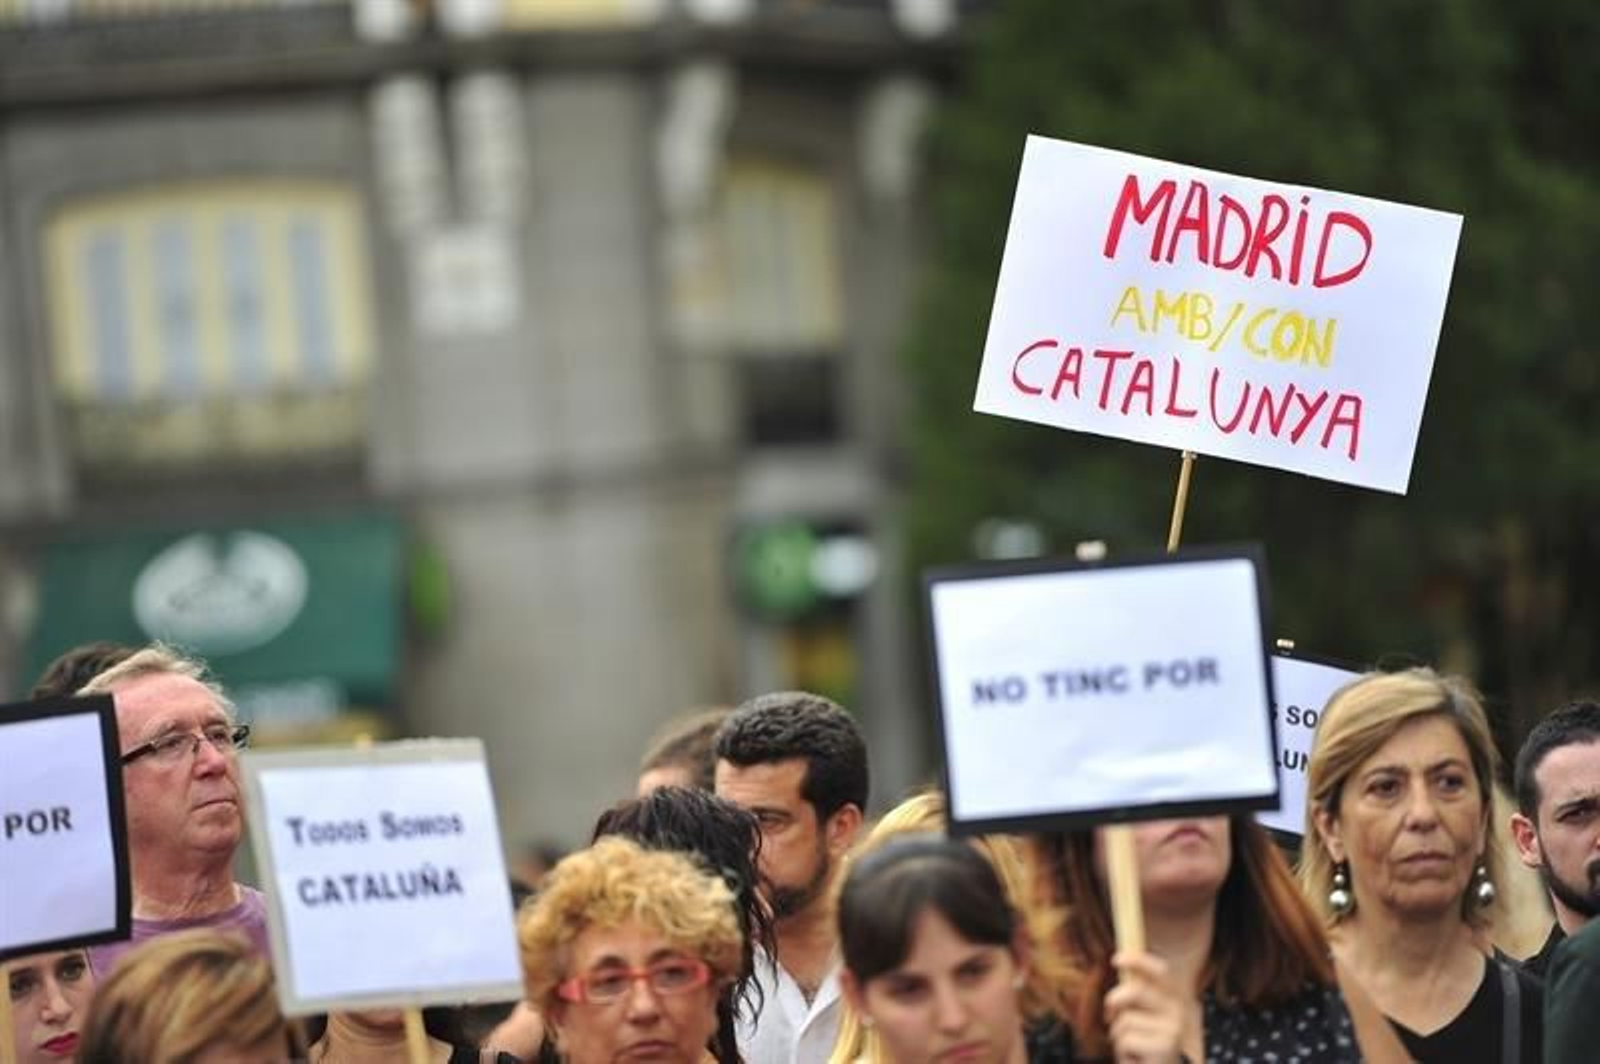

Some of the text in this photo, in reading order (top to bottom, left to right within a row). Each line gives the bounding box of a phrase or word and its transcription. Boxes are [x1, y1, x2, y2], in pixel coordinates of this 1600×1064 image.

[1111, 286, 1337, 367] AMB/CON
[1012, 340, 1363, 460] CATALUNYA
[972, 659, 1218, 705] NO TINC POR
[1286, 705, 1318, 729] SO
[4, 806, 74, 840] POR
[297, 862, 463, 906] CATALUÑA
